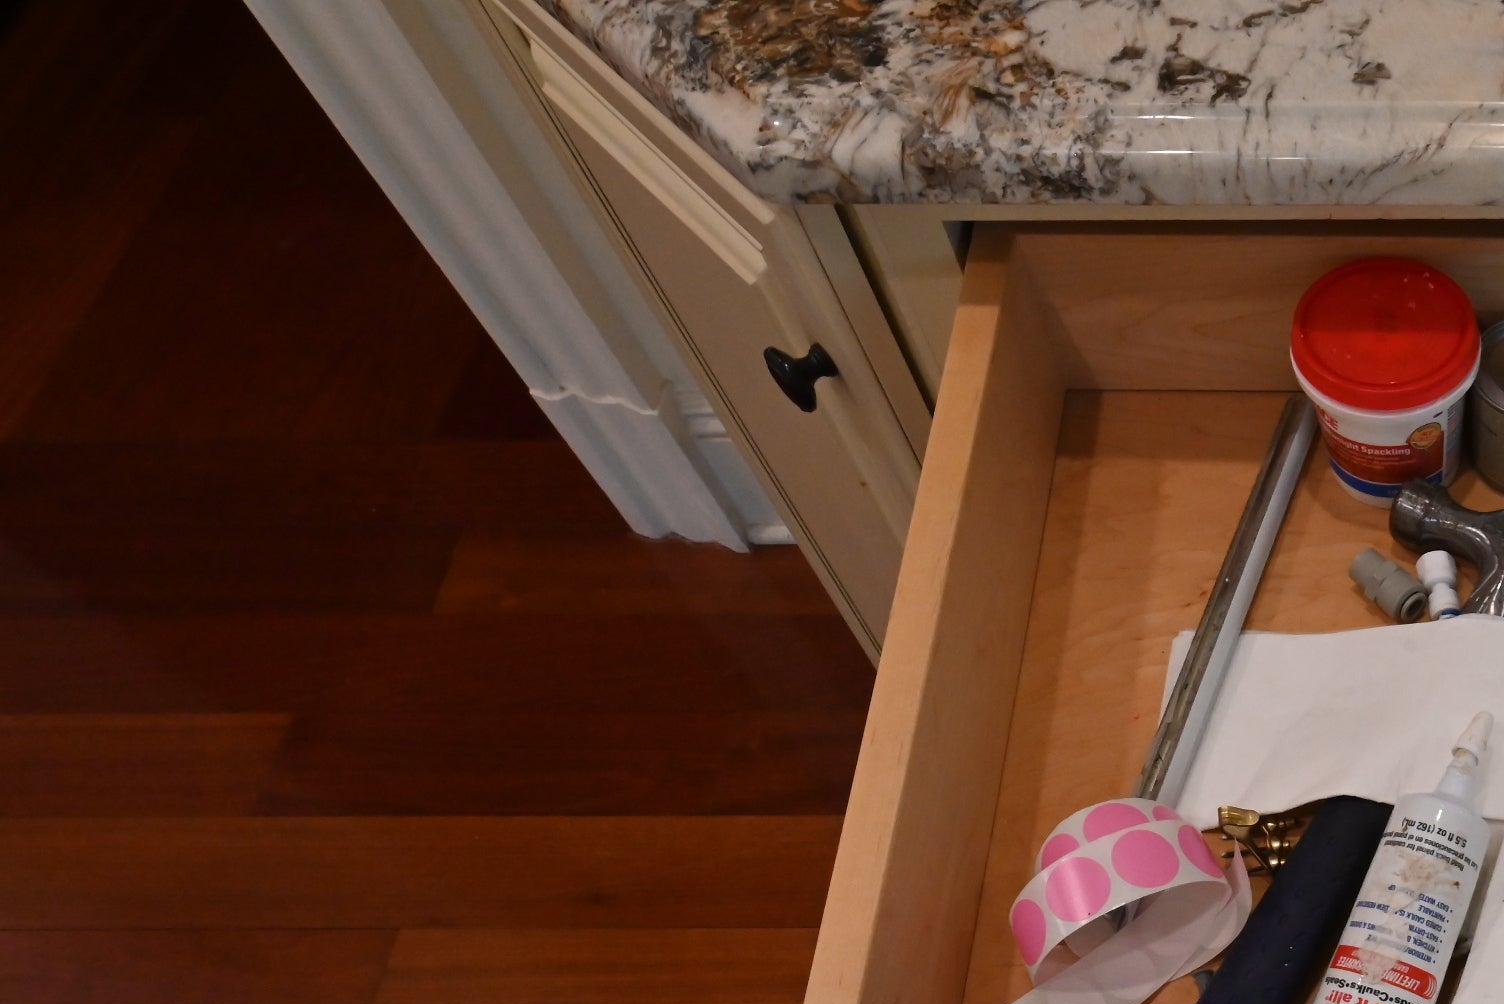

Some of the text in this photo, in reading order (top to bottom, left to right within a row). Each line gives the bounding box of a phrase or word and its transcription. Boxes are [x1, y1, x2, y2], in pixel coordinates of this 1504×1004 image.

[1361, 446, 1410, 456] Spackling
[1416, 822, 1436, 834] (162
[1436, 828, 1446, 836] oz
[1448, 833, 1454, 842] fl
[1416, 846, 1434, 856] panel
[1424, 838, 1464, 860] precauciones
[1436, 902, 1450, 912] EASY
[1407, 912, 1425, 924] CAULK
[1418, 904, 1446, 922] PAINTABLE
[1408, 924, 1440, 942] FAST-DRYIN
